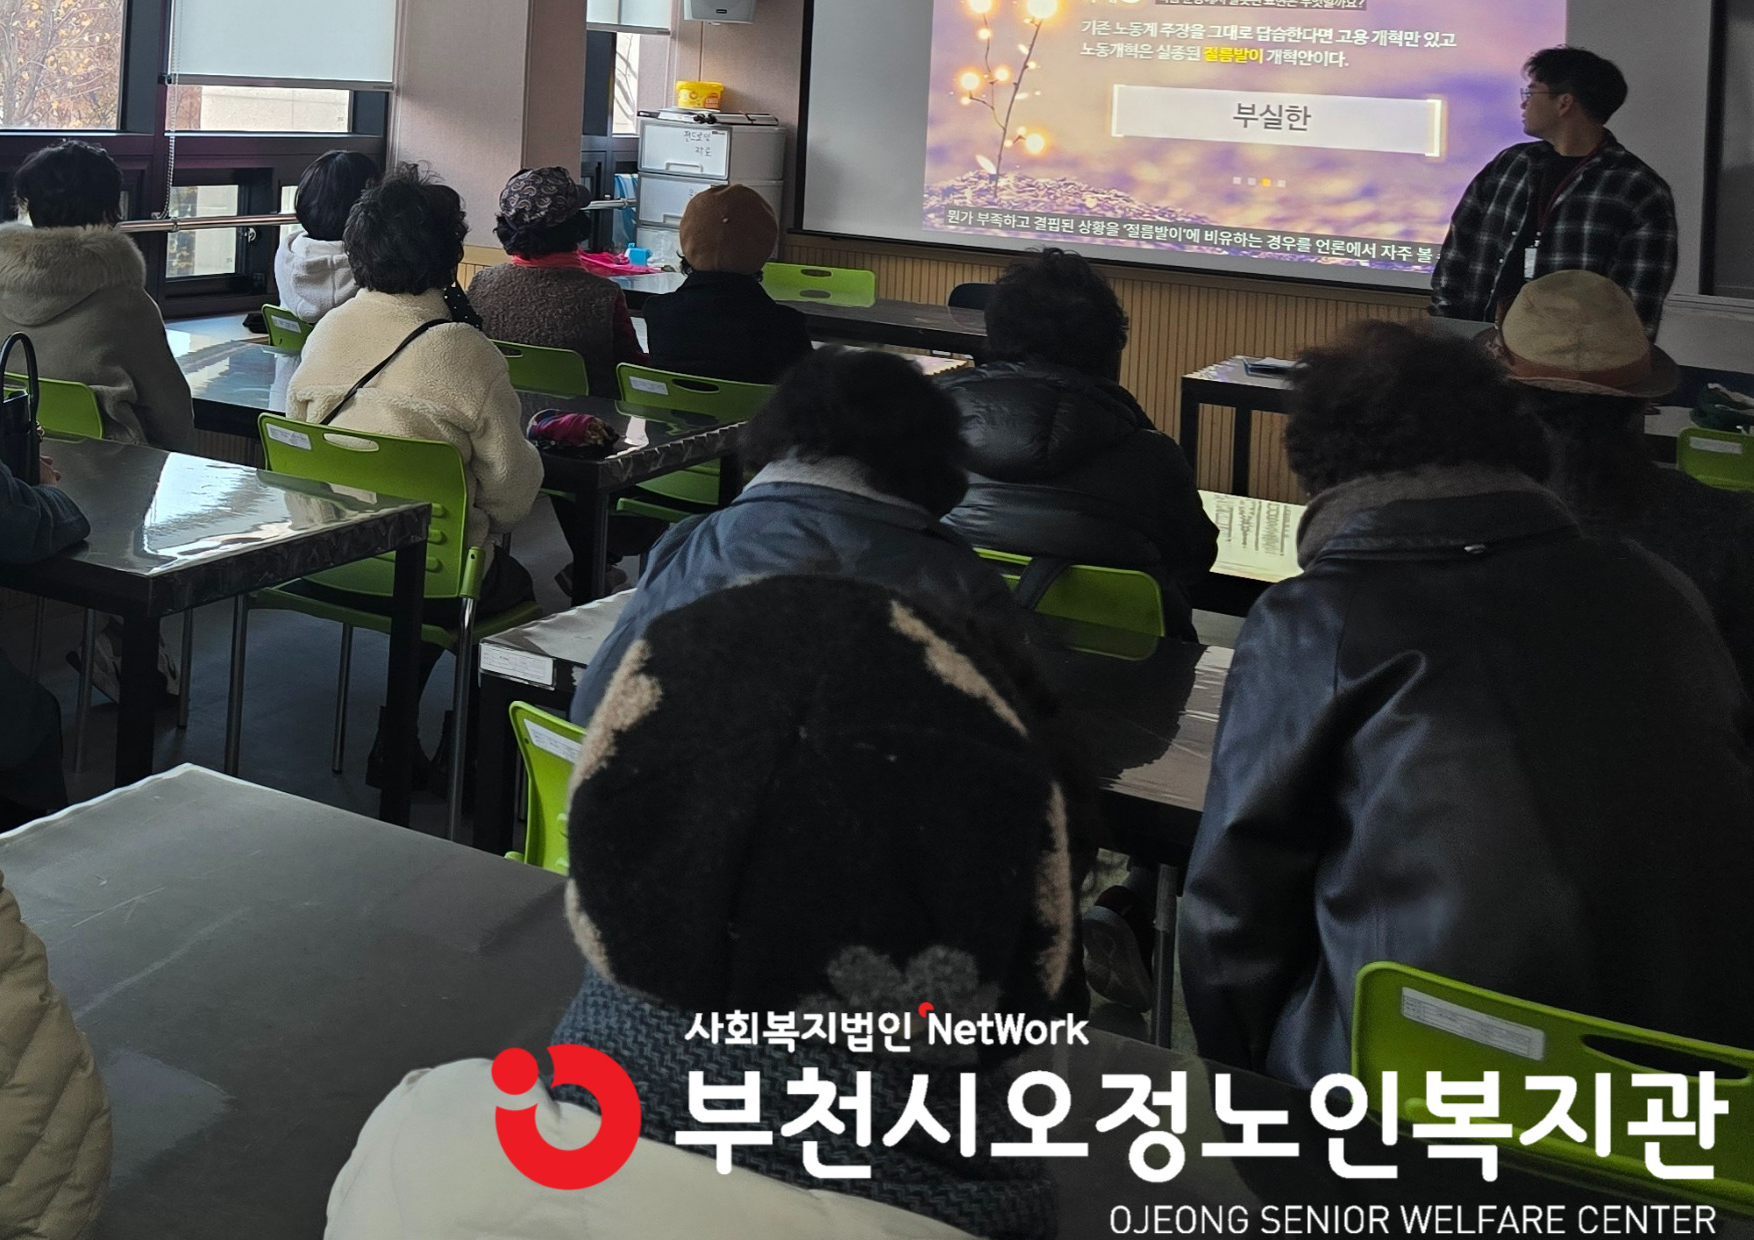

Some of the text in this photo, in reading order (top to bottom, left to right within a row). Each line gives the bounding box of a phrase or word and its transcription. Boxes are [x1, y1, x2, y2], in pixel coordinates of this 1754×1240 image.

[1082, 20, 1457, 48] 기존 노동계 주장을 그대로 답습한다면 고용 개혁만 있고
[1080, 42, 1349, 68] 노동개혁은 실종된 절름발이 개혁안이다.
[1233, 103, 1312, 131] 부실한
[947, 210, 974, 225] 뭔가
[977, 212, 1029, 229] 부족하고
[1033, 216, 1074, 233] 결핍된
[1078, 219, 1119, 236] 상황을
[1204, 229, 1263, 249] 비유하는
[1266, 234, 1311, 253] 경우를
[1315, 239, 1377, 259] 언론에서
[1381, 244, 1413, 261] 자주
[1417, 246, 1432, 264] 볼
